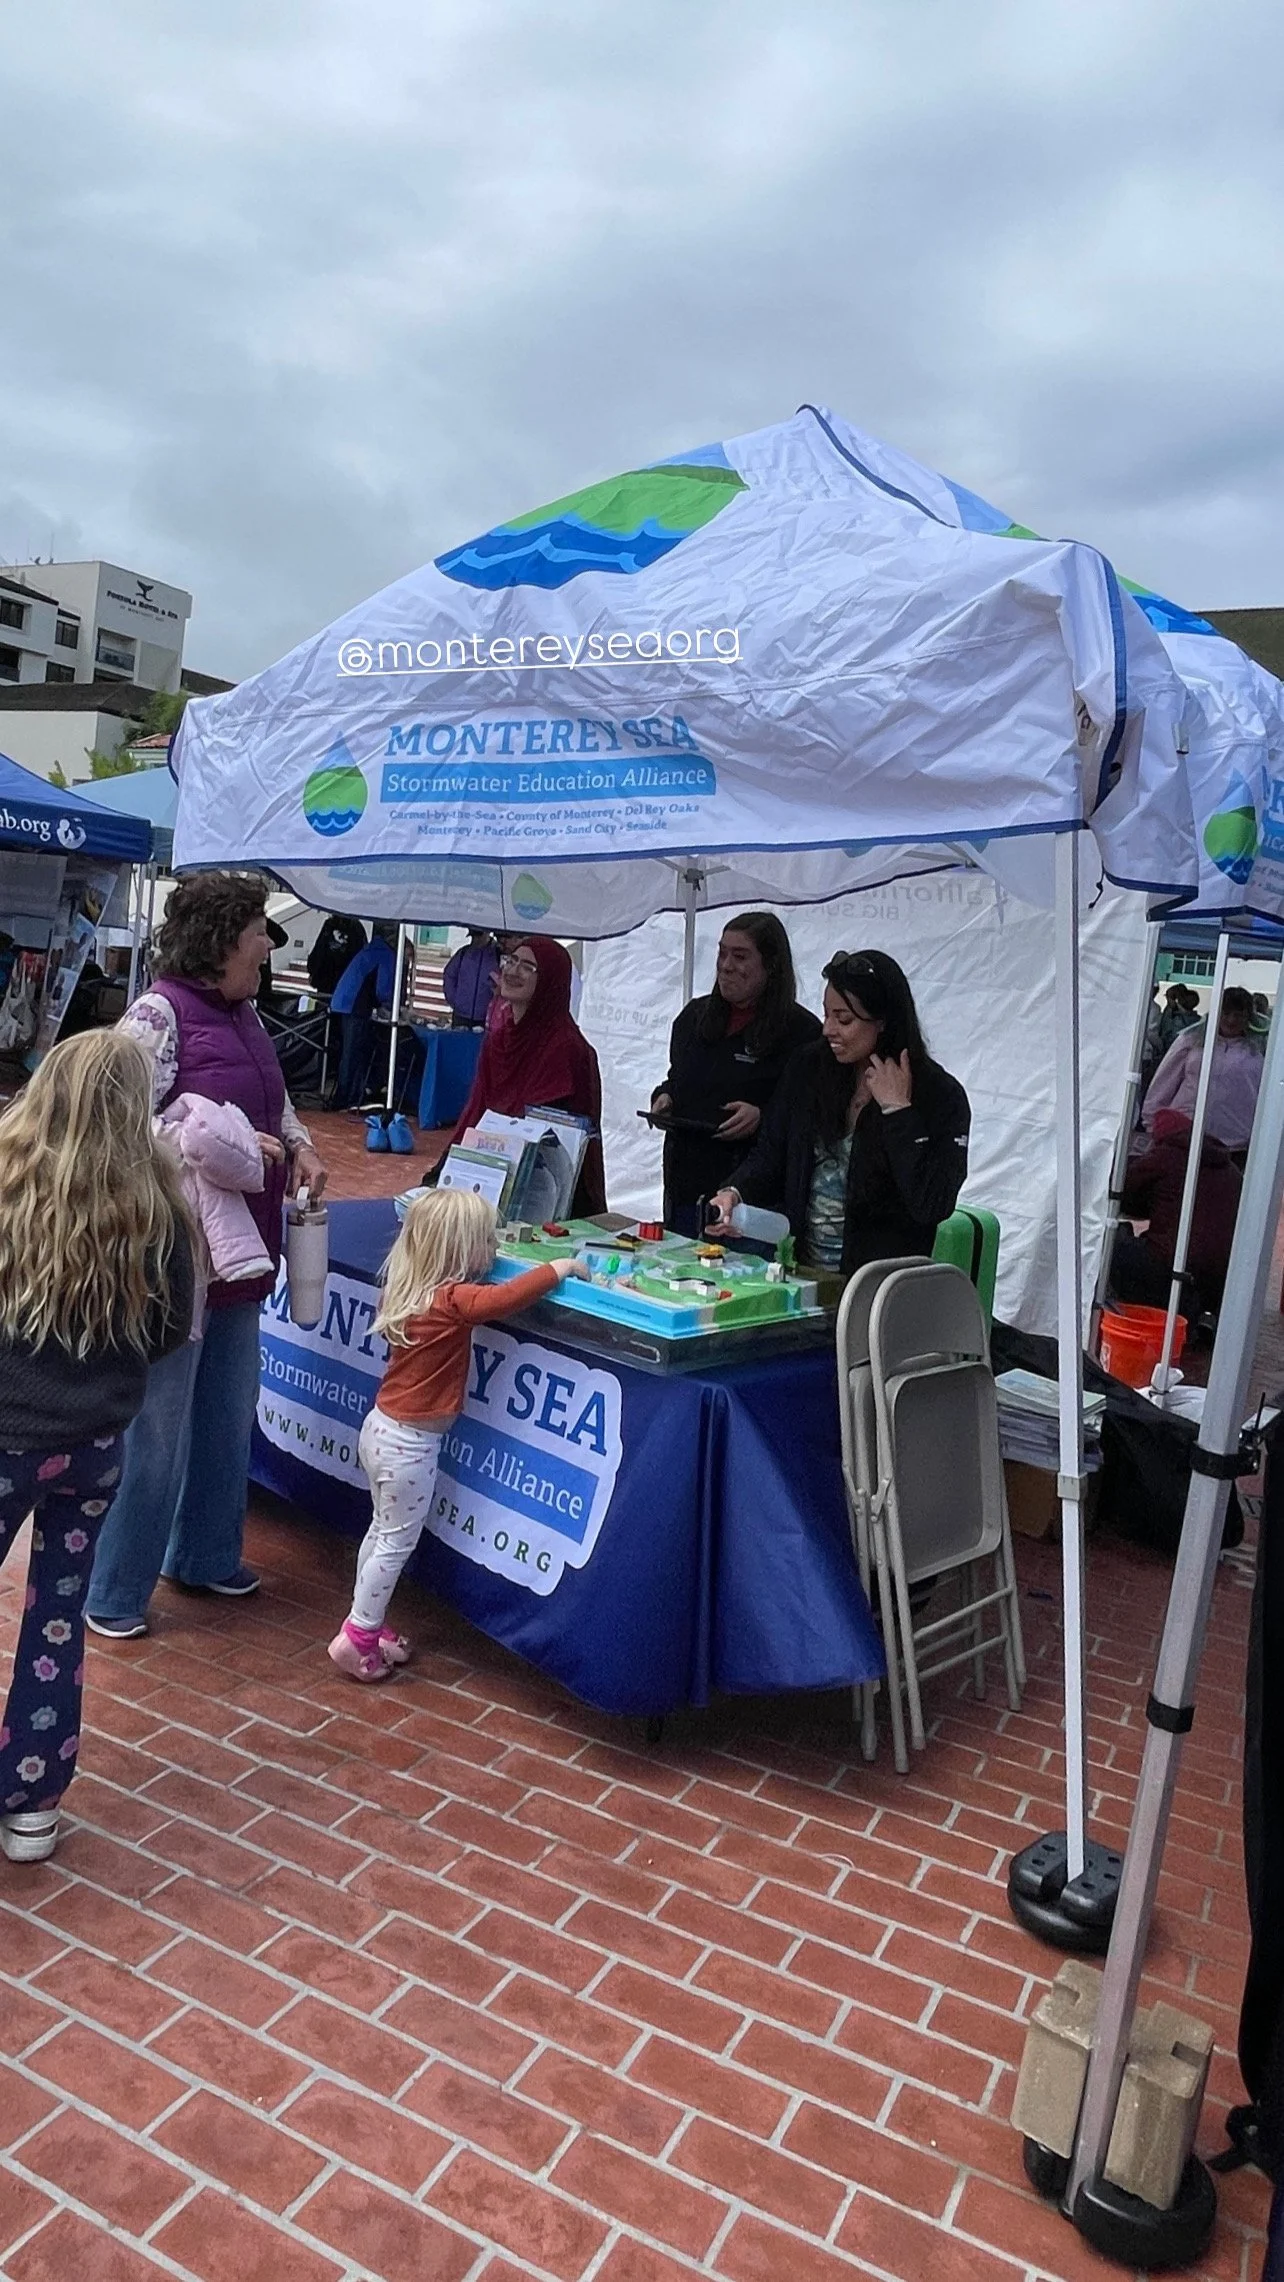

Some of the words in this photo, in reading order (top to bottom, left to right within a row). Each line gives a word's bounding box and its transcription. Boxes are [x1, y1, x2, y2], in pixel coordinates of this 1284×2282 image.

[384, 719, 623, 756] MONTEREY
[622, 715, 700, 751] SEA
[387, 773, 511, 793] Stormwater
[517, 770, 616, 793] Education
[621, 767, 707, 787] Alliance
[389, 810, 497, 822] Carmel-by-the-Sea
[506, 811, 547, 822] County
[550, 809, 562, 820] of
[564, 808, 615, 819] Monterey
[625, 804, 643, 816] Del
[645, 804, 666, 816] Rey
[669, 803, 700, 814] Oaks
[484, 826, 521, 837] Pacific
[523, 827, 557, 837] Grove
[565, 824, 591, 834] Sand
[594, 824, 616, 835] City
[626, 820, 667, 832] Seaside
[507, 1363, 607, 1456] SEA
[260, 1346, 368, 1414] Stormwater
[478, 1441, 583, 1520] Alliance
